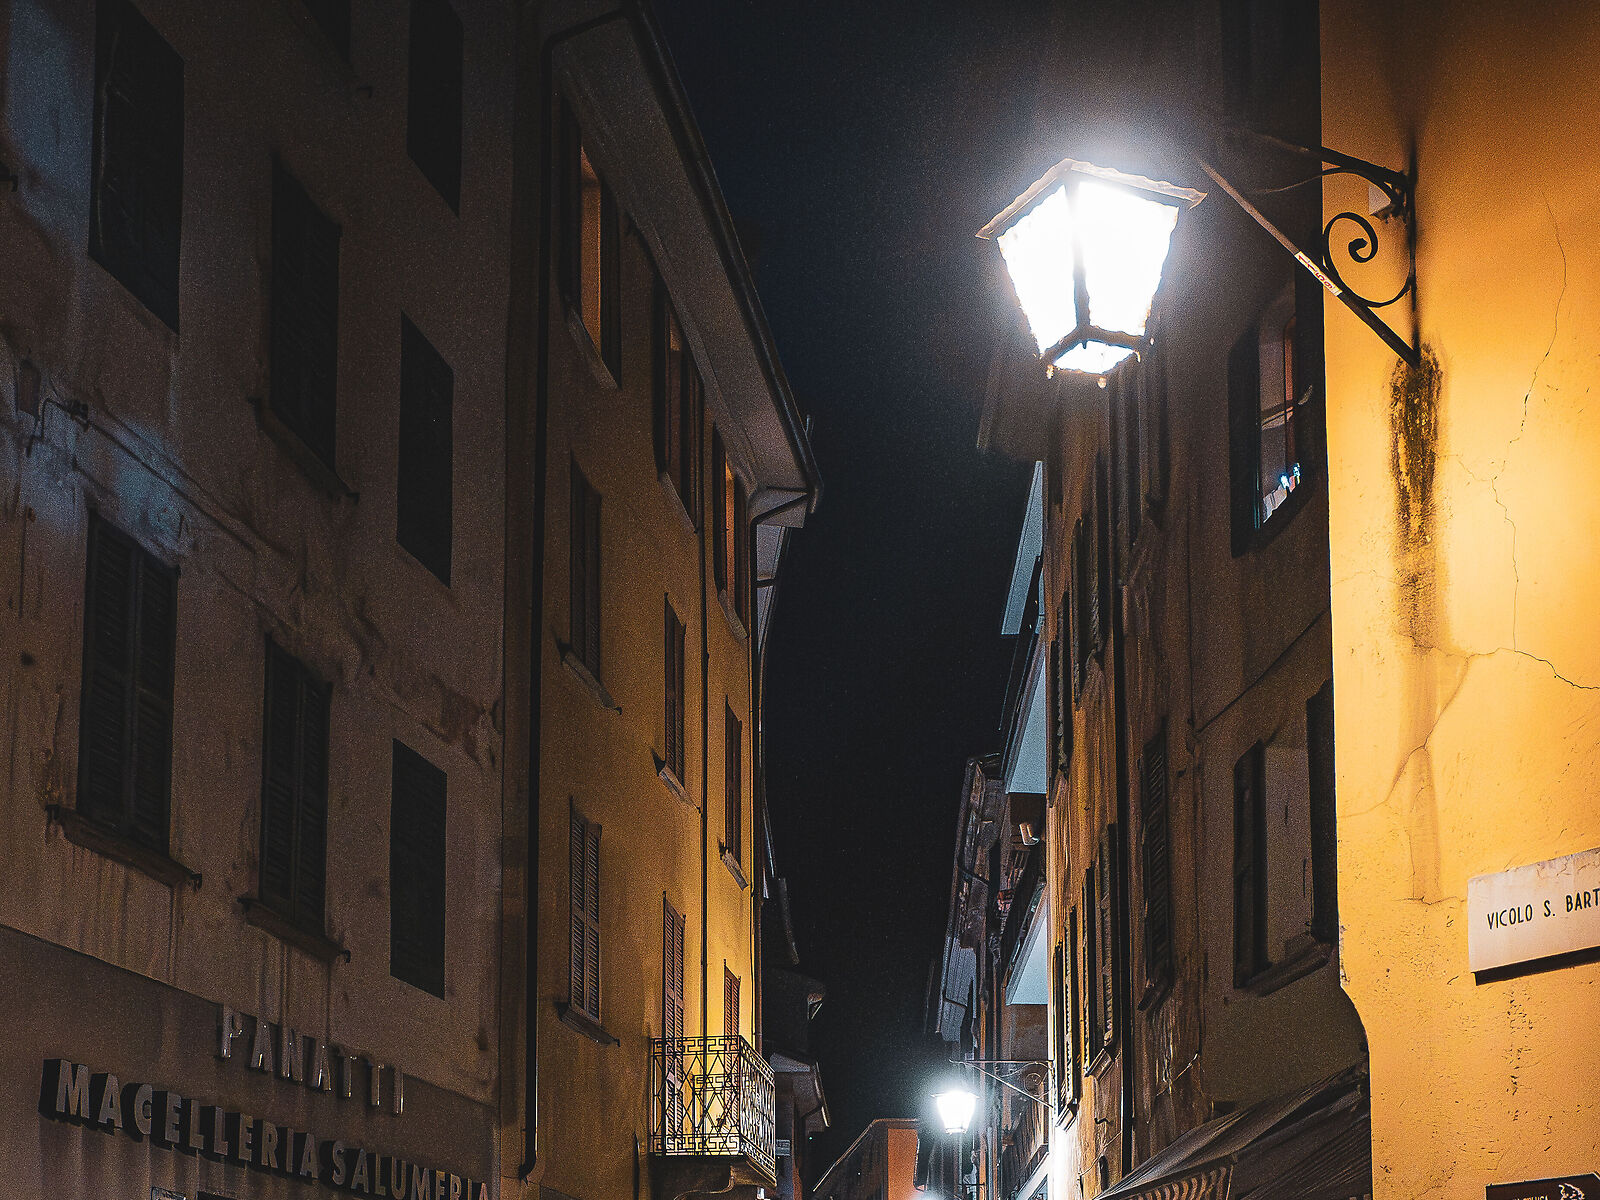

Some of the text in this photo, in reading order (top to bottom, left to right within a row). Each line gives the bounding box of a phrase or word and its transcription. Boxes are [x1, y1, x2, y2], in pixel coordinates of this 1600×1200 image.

[1487, 888, 1600, 930] VICOLO S. BART
[55, 1059, 319, 1179] MACELLERIA
